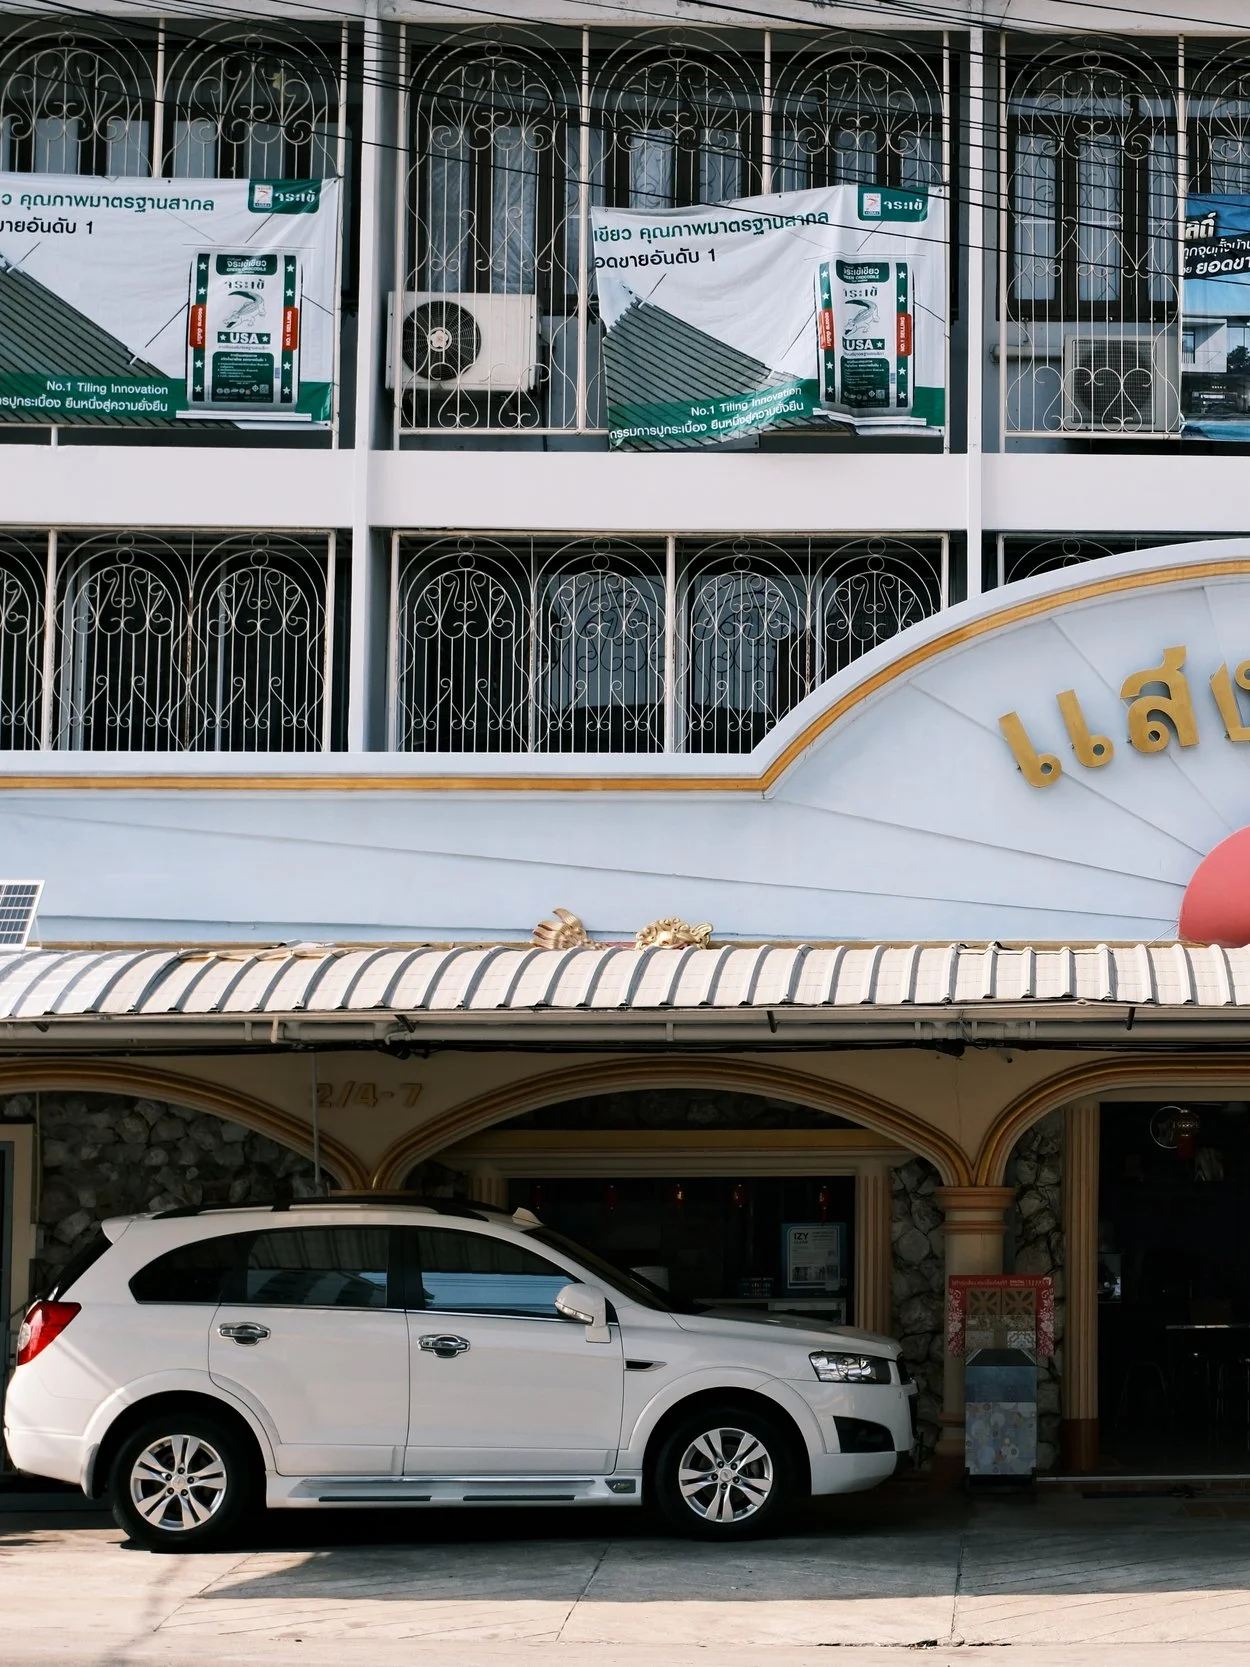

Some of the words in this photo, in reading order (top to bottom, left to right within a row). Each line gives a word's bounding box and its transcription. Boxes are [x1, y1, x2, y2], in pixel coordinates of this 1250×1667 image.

[20, 194, 214, 213] คุณภาพมาตรฐานสากล
[86, 220, 94, 235] 1
[640, 211, 829, 244] คุณภาพมาตรฐานสากล
[708, 248, 717, 262] 1
[229, 332, 260, 345] USA
[846, 339, 874, 351] USA
[46, 380, 72, 392] No.1
[77, 382, 107, 395] Tiling
[111, 384, 169, 395] Innovation
[691, 405, 715, 417] No.1
[720, 400, 749, 413] Tiling
[751, 387, 802, 408] Innovation
[312, 1080, 424, 1109] 2/4-7
